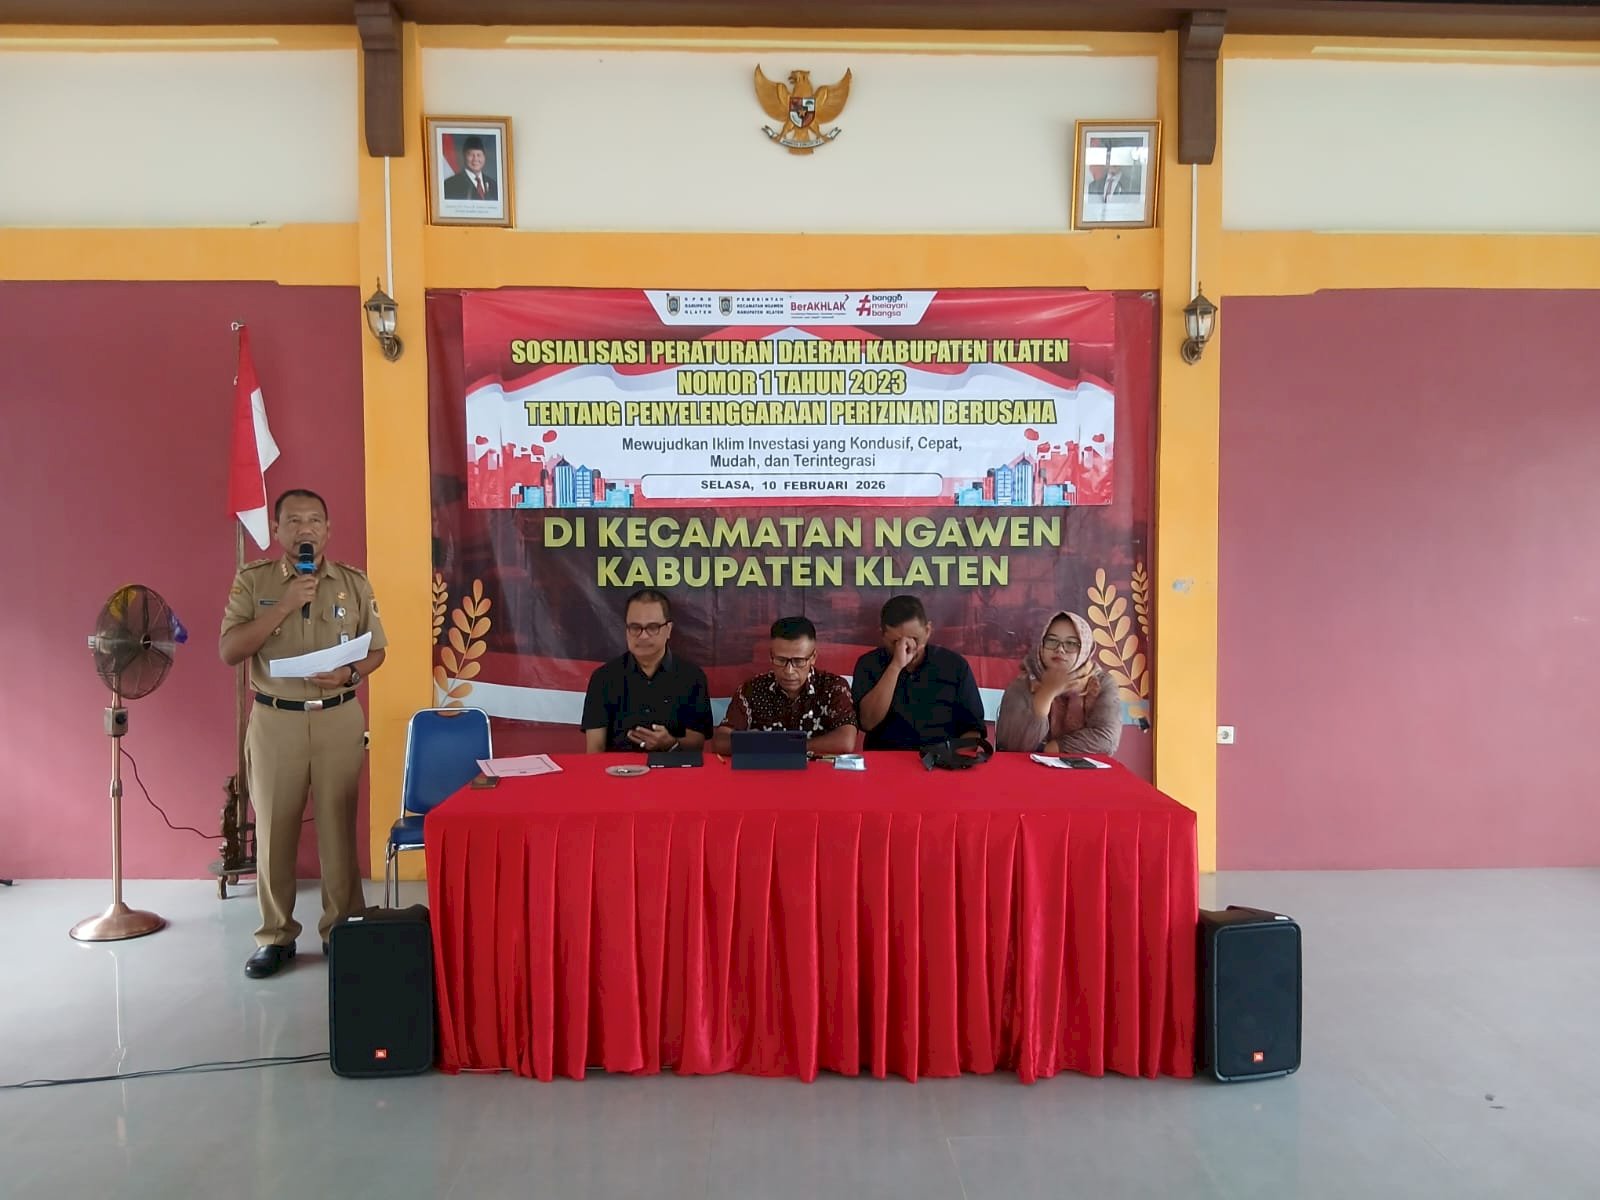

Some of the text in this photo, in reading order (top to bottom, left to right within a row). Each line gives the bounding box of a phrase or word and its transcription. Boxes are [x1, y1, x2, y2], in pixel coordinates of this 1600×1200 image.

[790, 301, 847, 311] BerAKHLAK
[871, 310, 902, 318] bangsa
[511, 338, 1070, 365] SOSIALISASI PERATURAN DAERAH KABUPATEN KLATEN
[677, 370, 907, 396] NOMOR 1 TAHUN 2023
[525, 399, 1057, 426] TENTANG PENYELENGGARAAN PERIZINAN BERUSAHA
[622, 436, 963, 454] Mewujudkan Iklim Investasi yang Kondusif, Cepat,
[710, 453, 876, 470] Mudah, dan Terintegrasi
[701, 480, 886, 491] SELASA, 10 FEBRUARI 2026
[544, 516, 1061, 548] DI KECAMATAN NGAWEN
[597, 555, 1009, 587] KABUPATEN KLATEN
